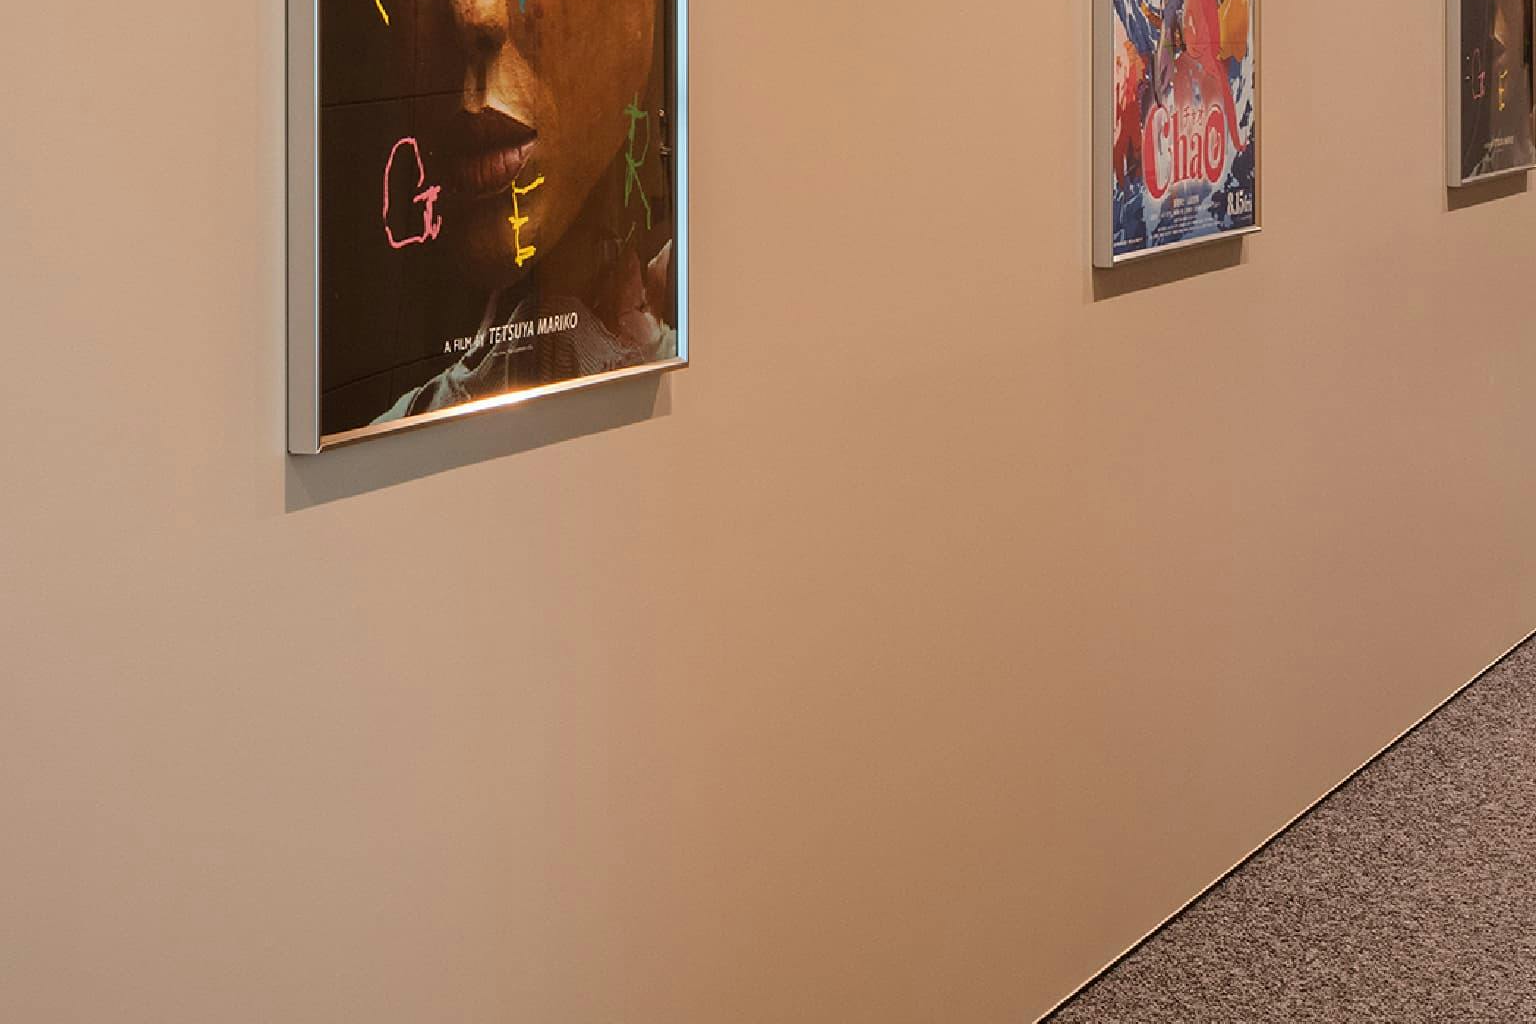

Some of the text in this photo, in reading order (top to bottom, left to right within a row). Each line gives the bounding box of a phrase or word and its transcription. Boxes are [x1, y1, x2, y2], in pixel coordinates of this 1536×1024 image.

[444, 341, 452, 354] A
[454, 336, 472, 353] FILM
[489, 320, 535, 345] TETSUYA
[537, 311, 578, 336] MARIKO
